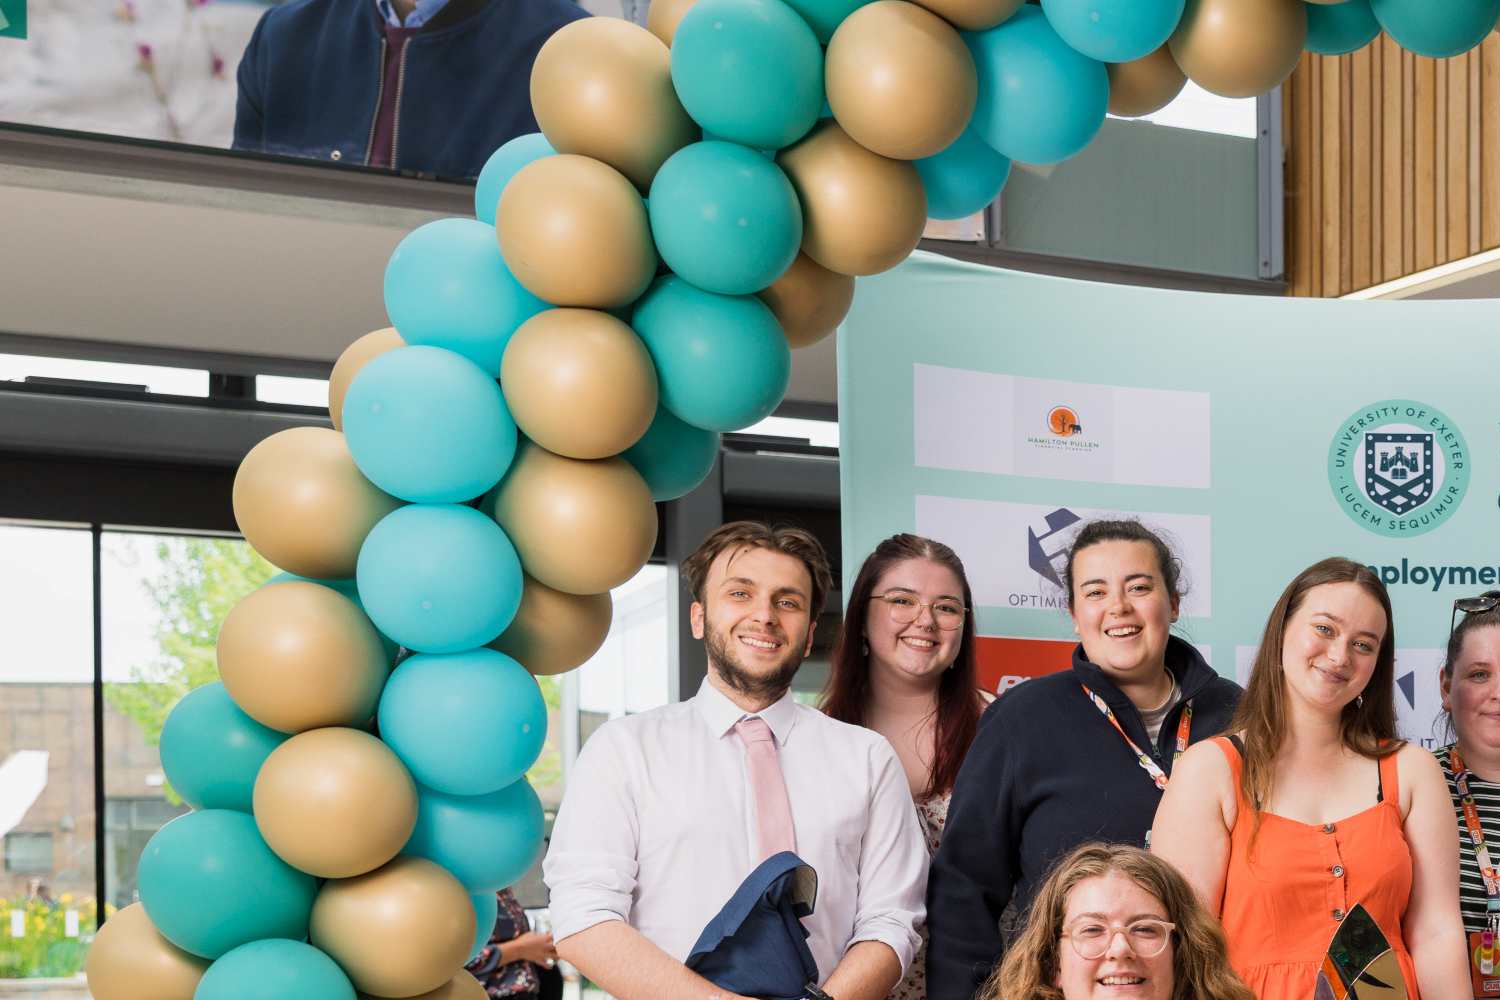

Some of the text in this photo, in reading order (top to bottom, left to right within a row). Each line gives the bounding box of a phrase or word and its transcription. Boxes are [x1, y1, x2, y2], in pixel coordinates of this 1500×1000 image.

[1336, 406, 1463, 469] UNIVERSITY OF EXETER
[1340, 484, 1460, 530] LUCEM SEQUIMUR
